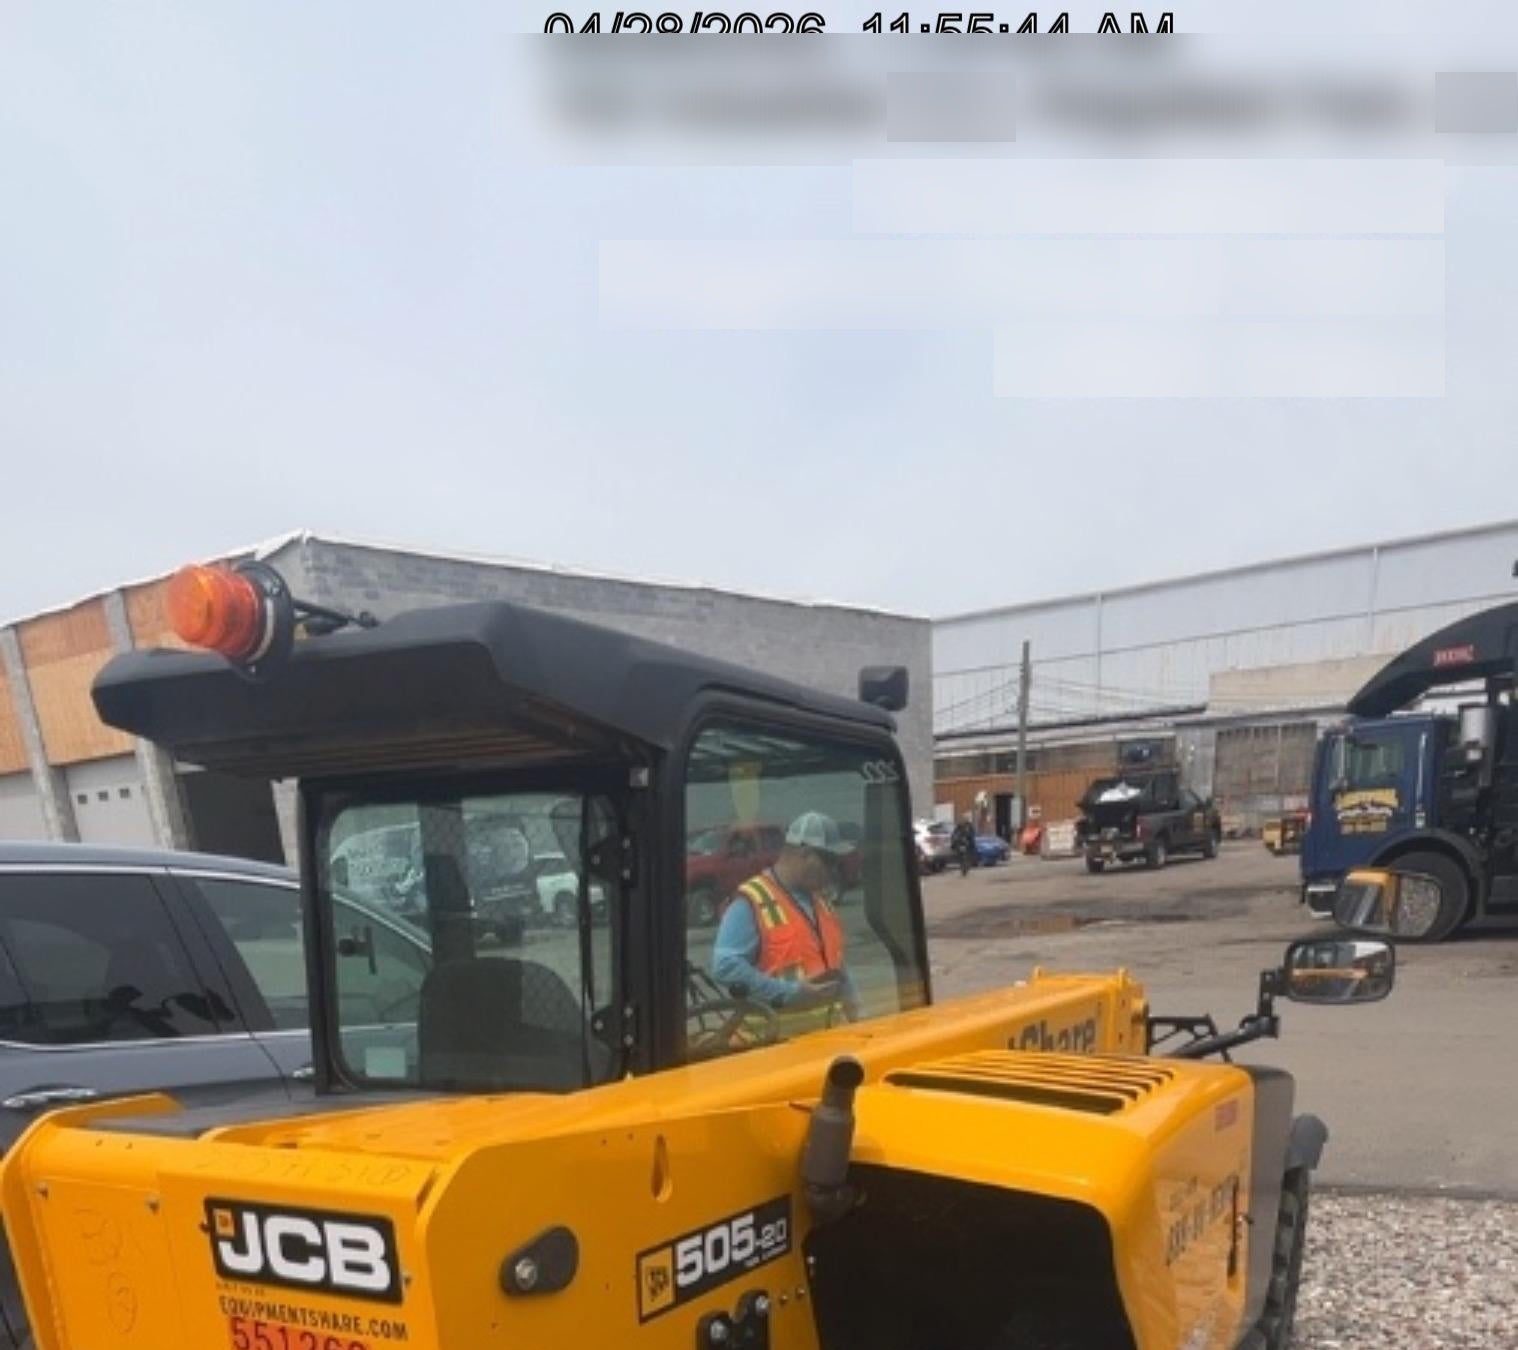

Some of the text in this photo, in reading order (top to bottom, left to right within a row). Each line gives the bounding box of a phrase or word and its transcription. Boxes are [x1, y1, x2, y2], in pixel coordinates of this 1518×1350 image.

[218, 1211, 391, 1291] JCB
[676, 1213, 787, 1288] 505-20
[219, 1296, 408, 1341] EQUIPMENTSHARE.COM
